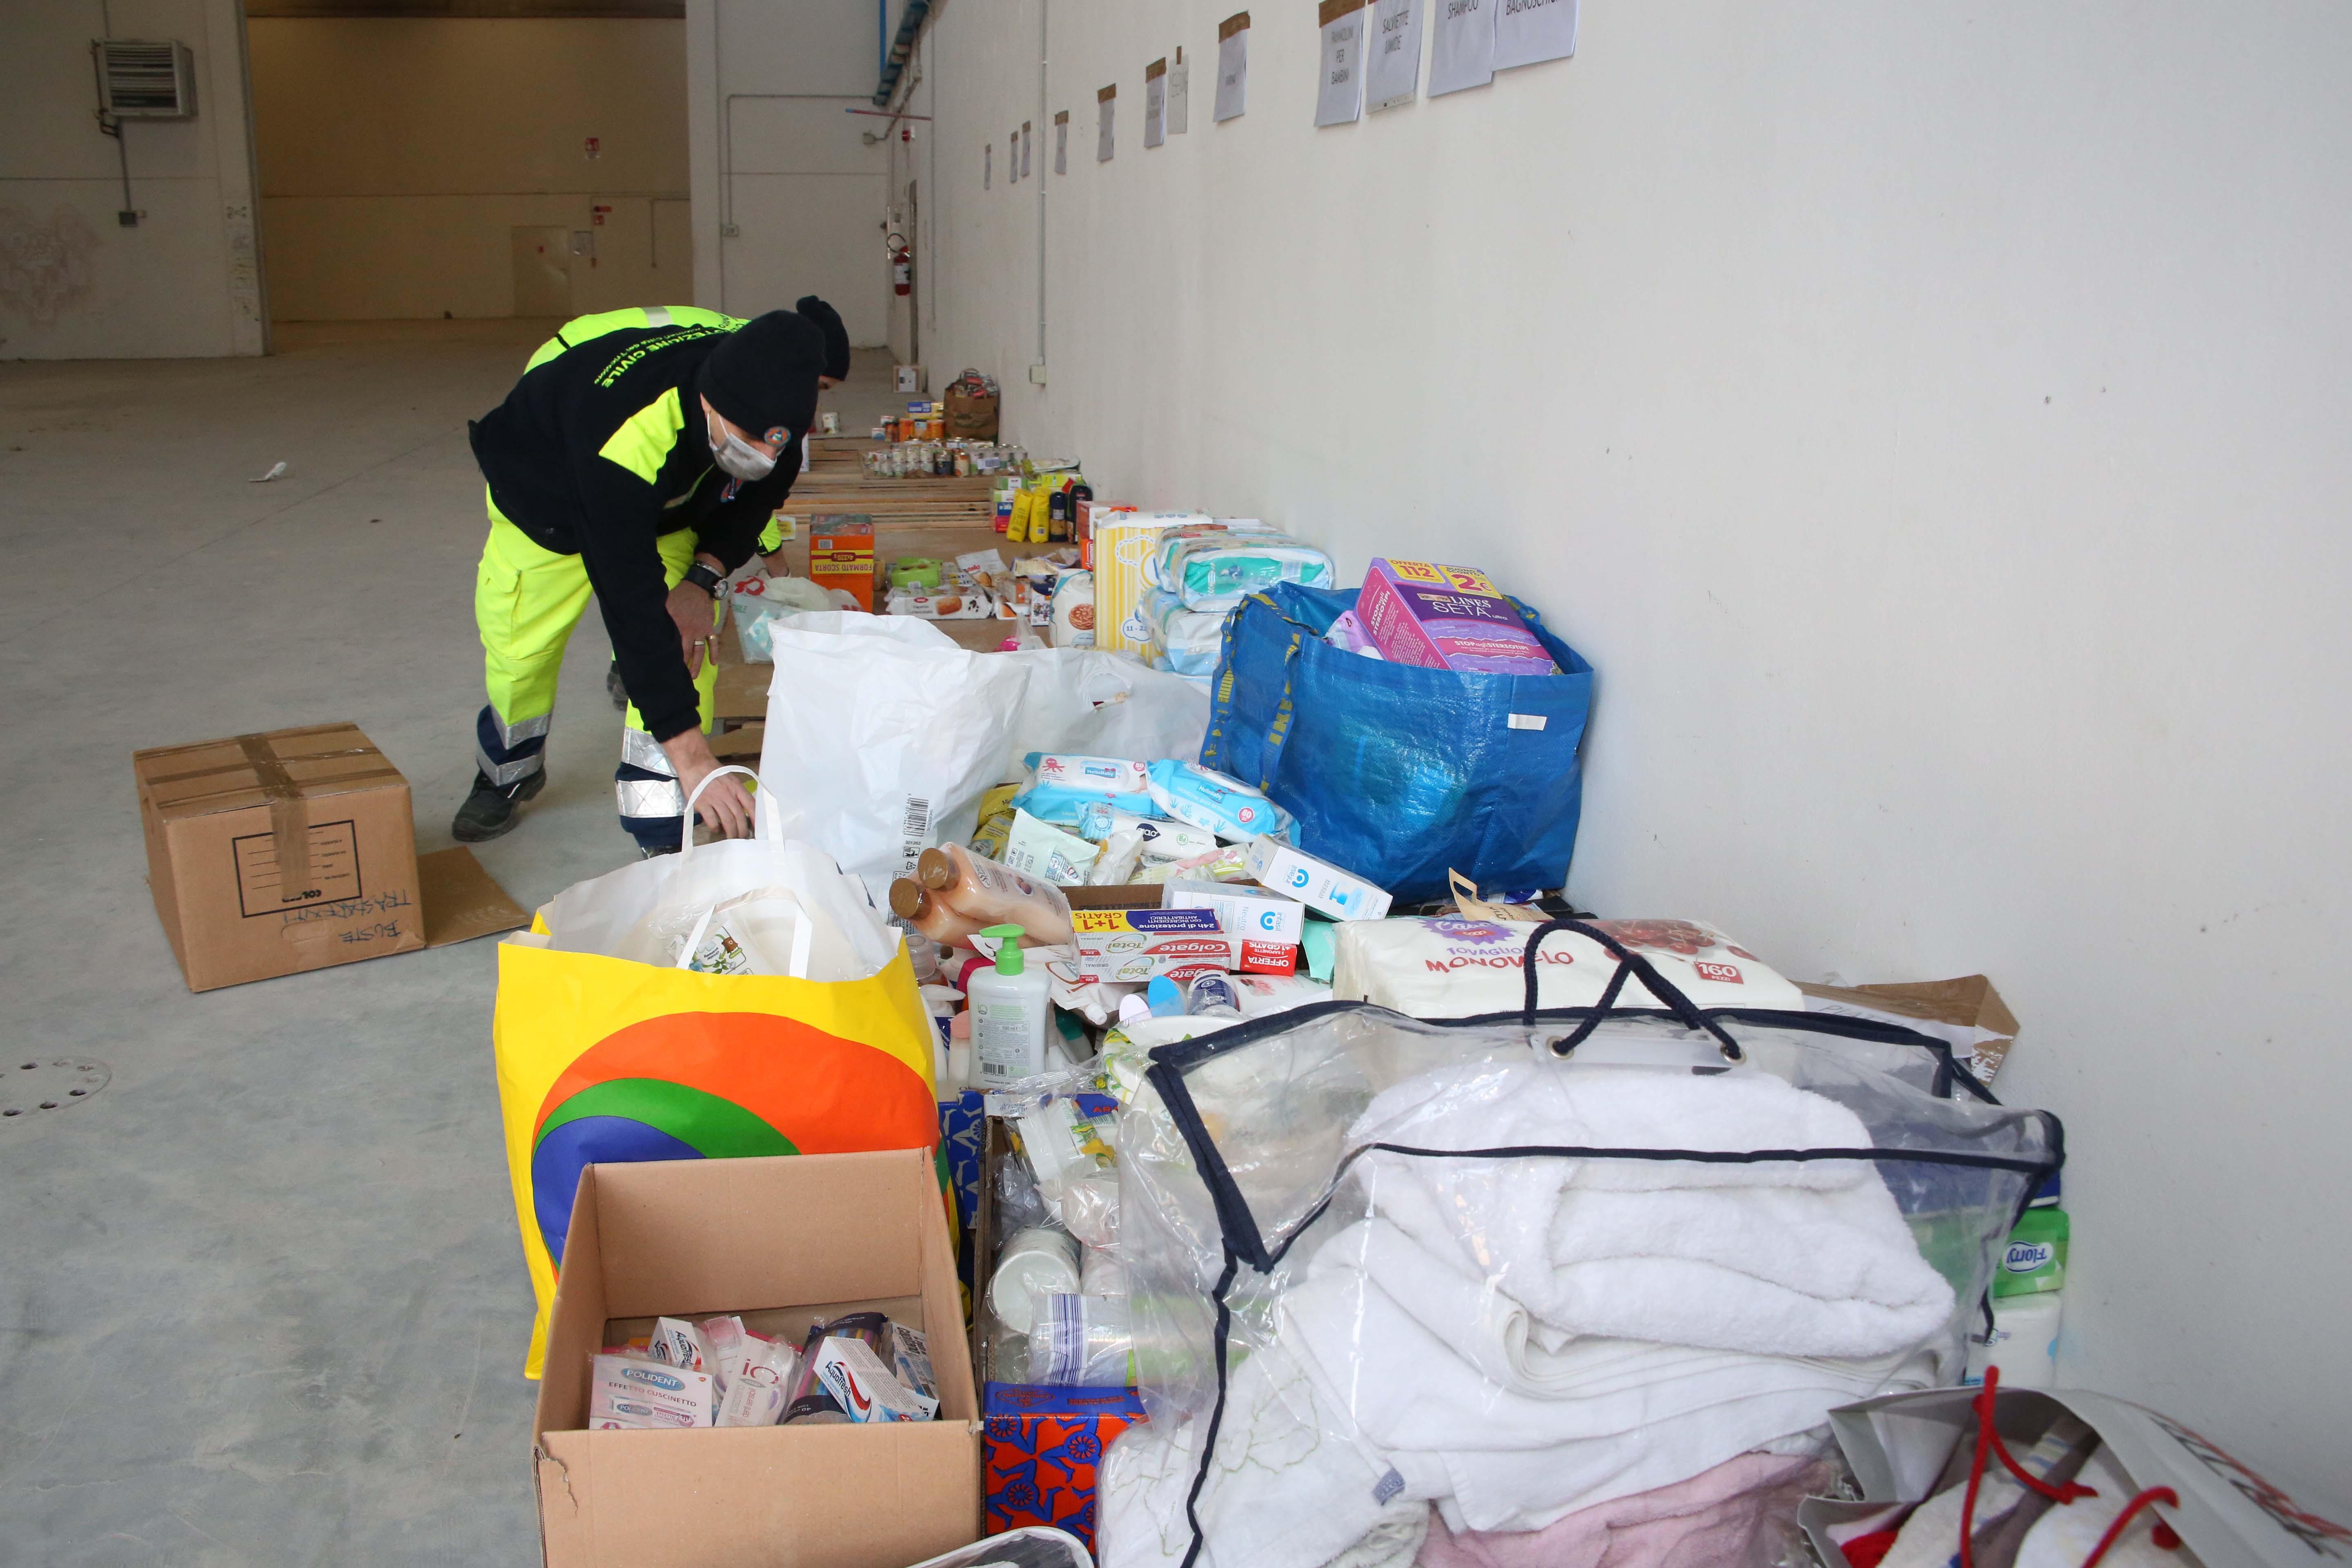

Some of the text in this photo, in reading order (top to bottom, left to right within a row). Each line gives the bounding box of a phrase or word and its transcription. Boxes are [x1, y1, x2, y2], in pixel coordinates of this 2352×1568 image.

[601, 350, 646, 388] CIVILE
[1390, 560, 1431, 568] OFFERTA
[1399, 565, 1435, 578] 112
[1432, 601, 1492, 618] SETA
[1449, 596, 1492, 608] LINES
[1373, 590, 1390, 636] STEREOTIPI
[1087, 768, 1114, 777] HelloBaby
[1198, 785, 1223, 800] HelloBaby
[1241, 809, 1252, 819] 80
[1285, 864, 1297, 884] infasil
[1082, 919, 1120, 930] 1+1
[1240, 906, 1249, 931] Neutro
[1275, 912, 1284, 931] infasil
[339, 920, 401, 944] BUSTE
[704, 946, 719, 958] economy
[1160, 943, 1226, 952] Colgate
[706, 950, 720, 961] circular
[1247, 956, 1289, 967] OFFERTA
[1116, 967, 1151, 977] Total
[1698, 962, 1737, 978] 160
[626, 1370, 679, 1387] POLIDENT
[825, 1361, 852, 1398] Aquafresh
[609, 1382, 697, 1407] EFFETTO CUSCINETTO
